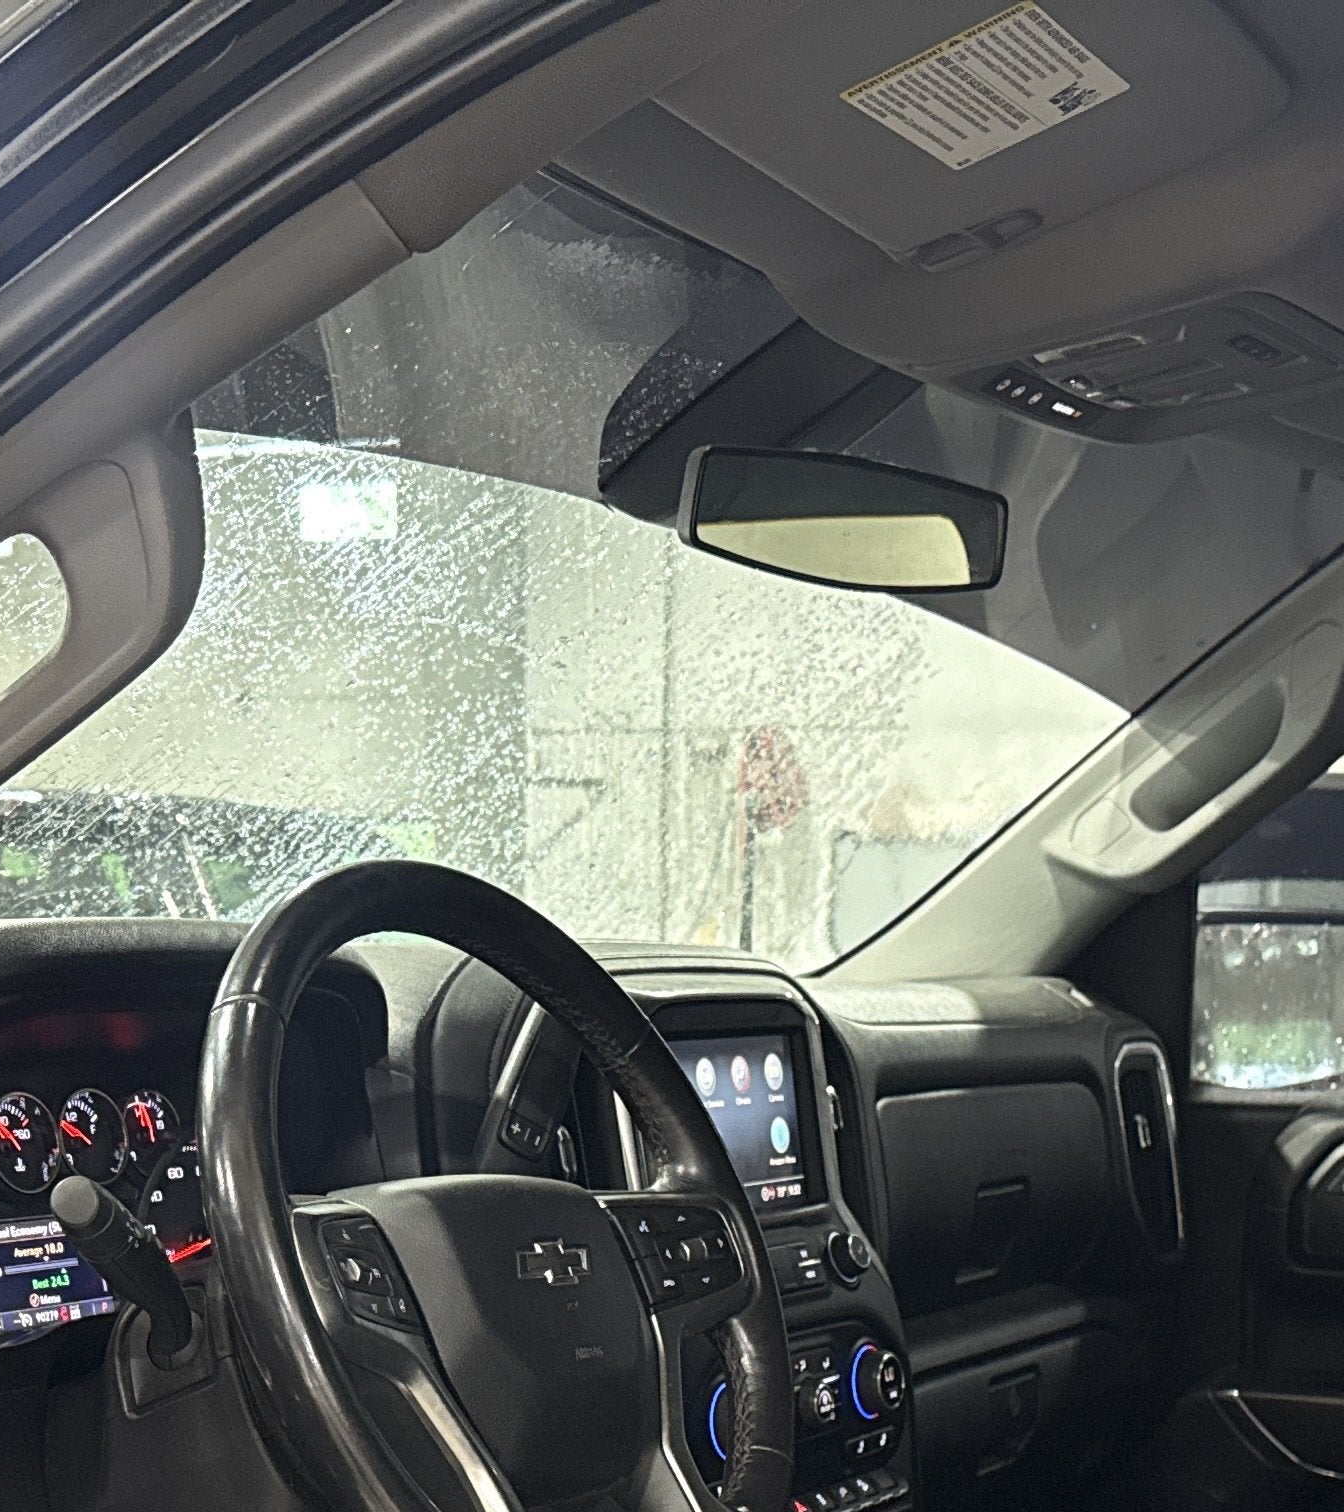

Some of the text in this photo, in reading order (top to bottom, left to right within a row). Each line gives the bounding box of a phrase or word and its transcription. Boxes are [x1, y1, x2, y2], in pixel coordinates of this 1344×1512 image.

[963, 5, 1025, 39] WARNING
[847, 47, 944, 98] AVERTISSEMENT
[167, 1167, 184, 1180] 60
